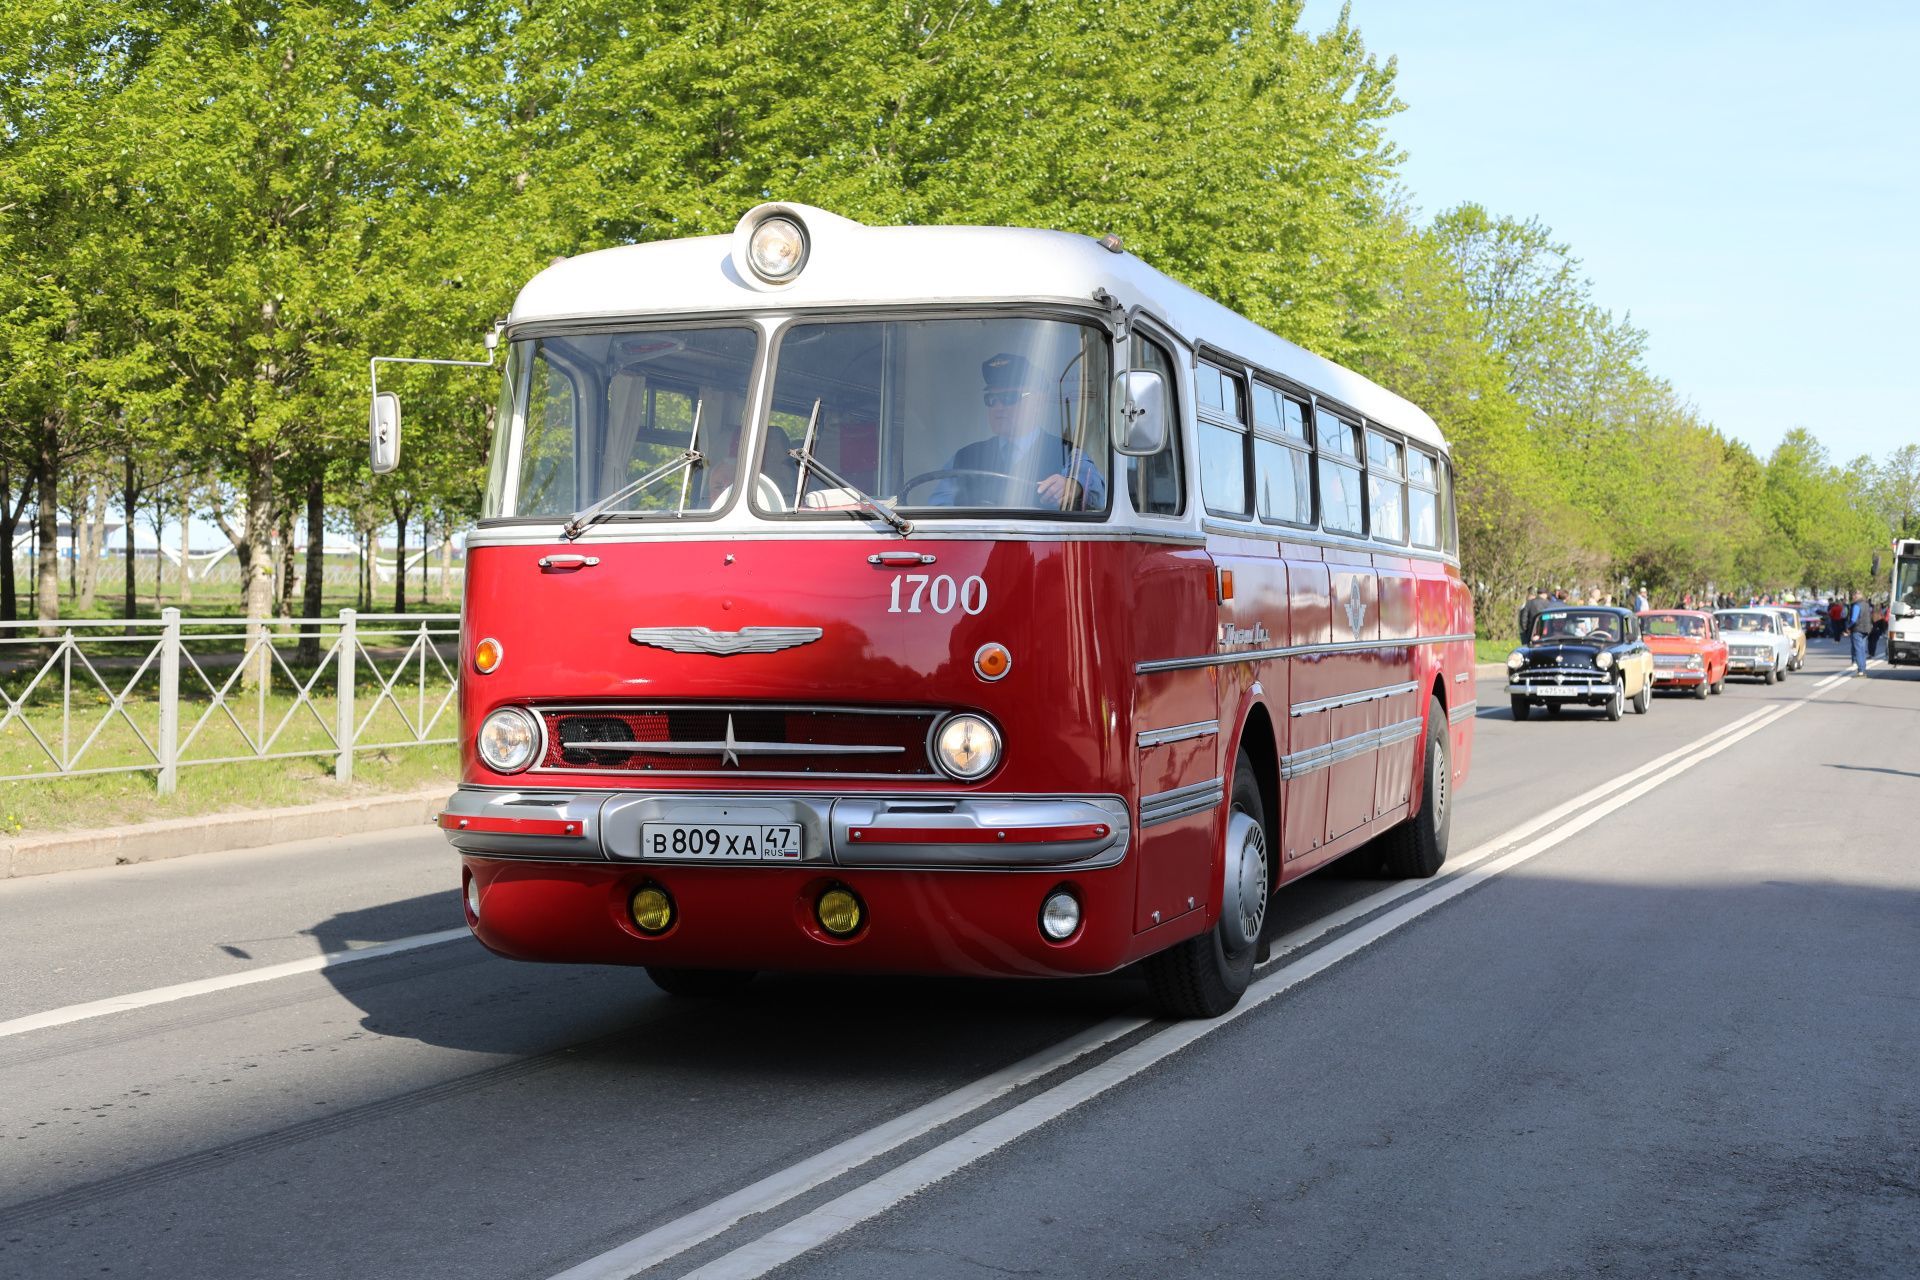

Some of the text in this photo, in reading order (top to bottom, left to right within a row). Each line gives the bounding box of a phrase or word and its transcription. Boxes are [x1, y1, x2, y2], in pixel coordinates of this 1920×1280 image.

[887, 574, 988, 615] 1700
[765, 828, 791, 849] 47
[764, 848, 784, 857] RUS
